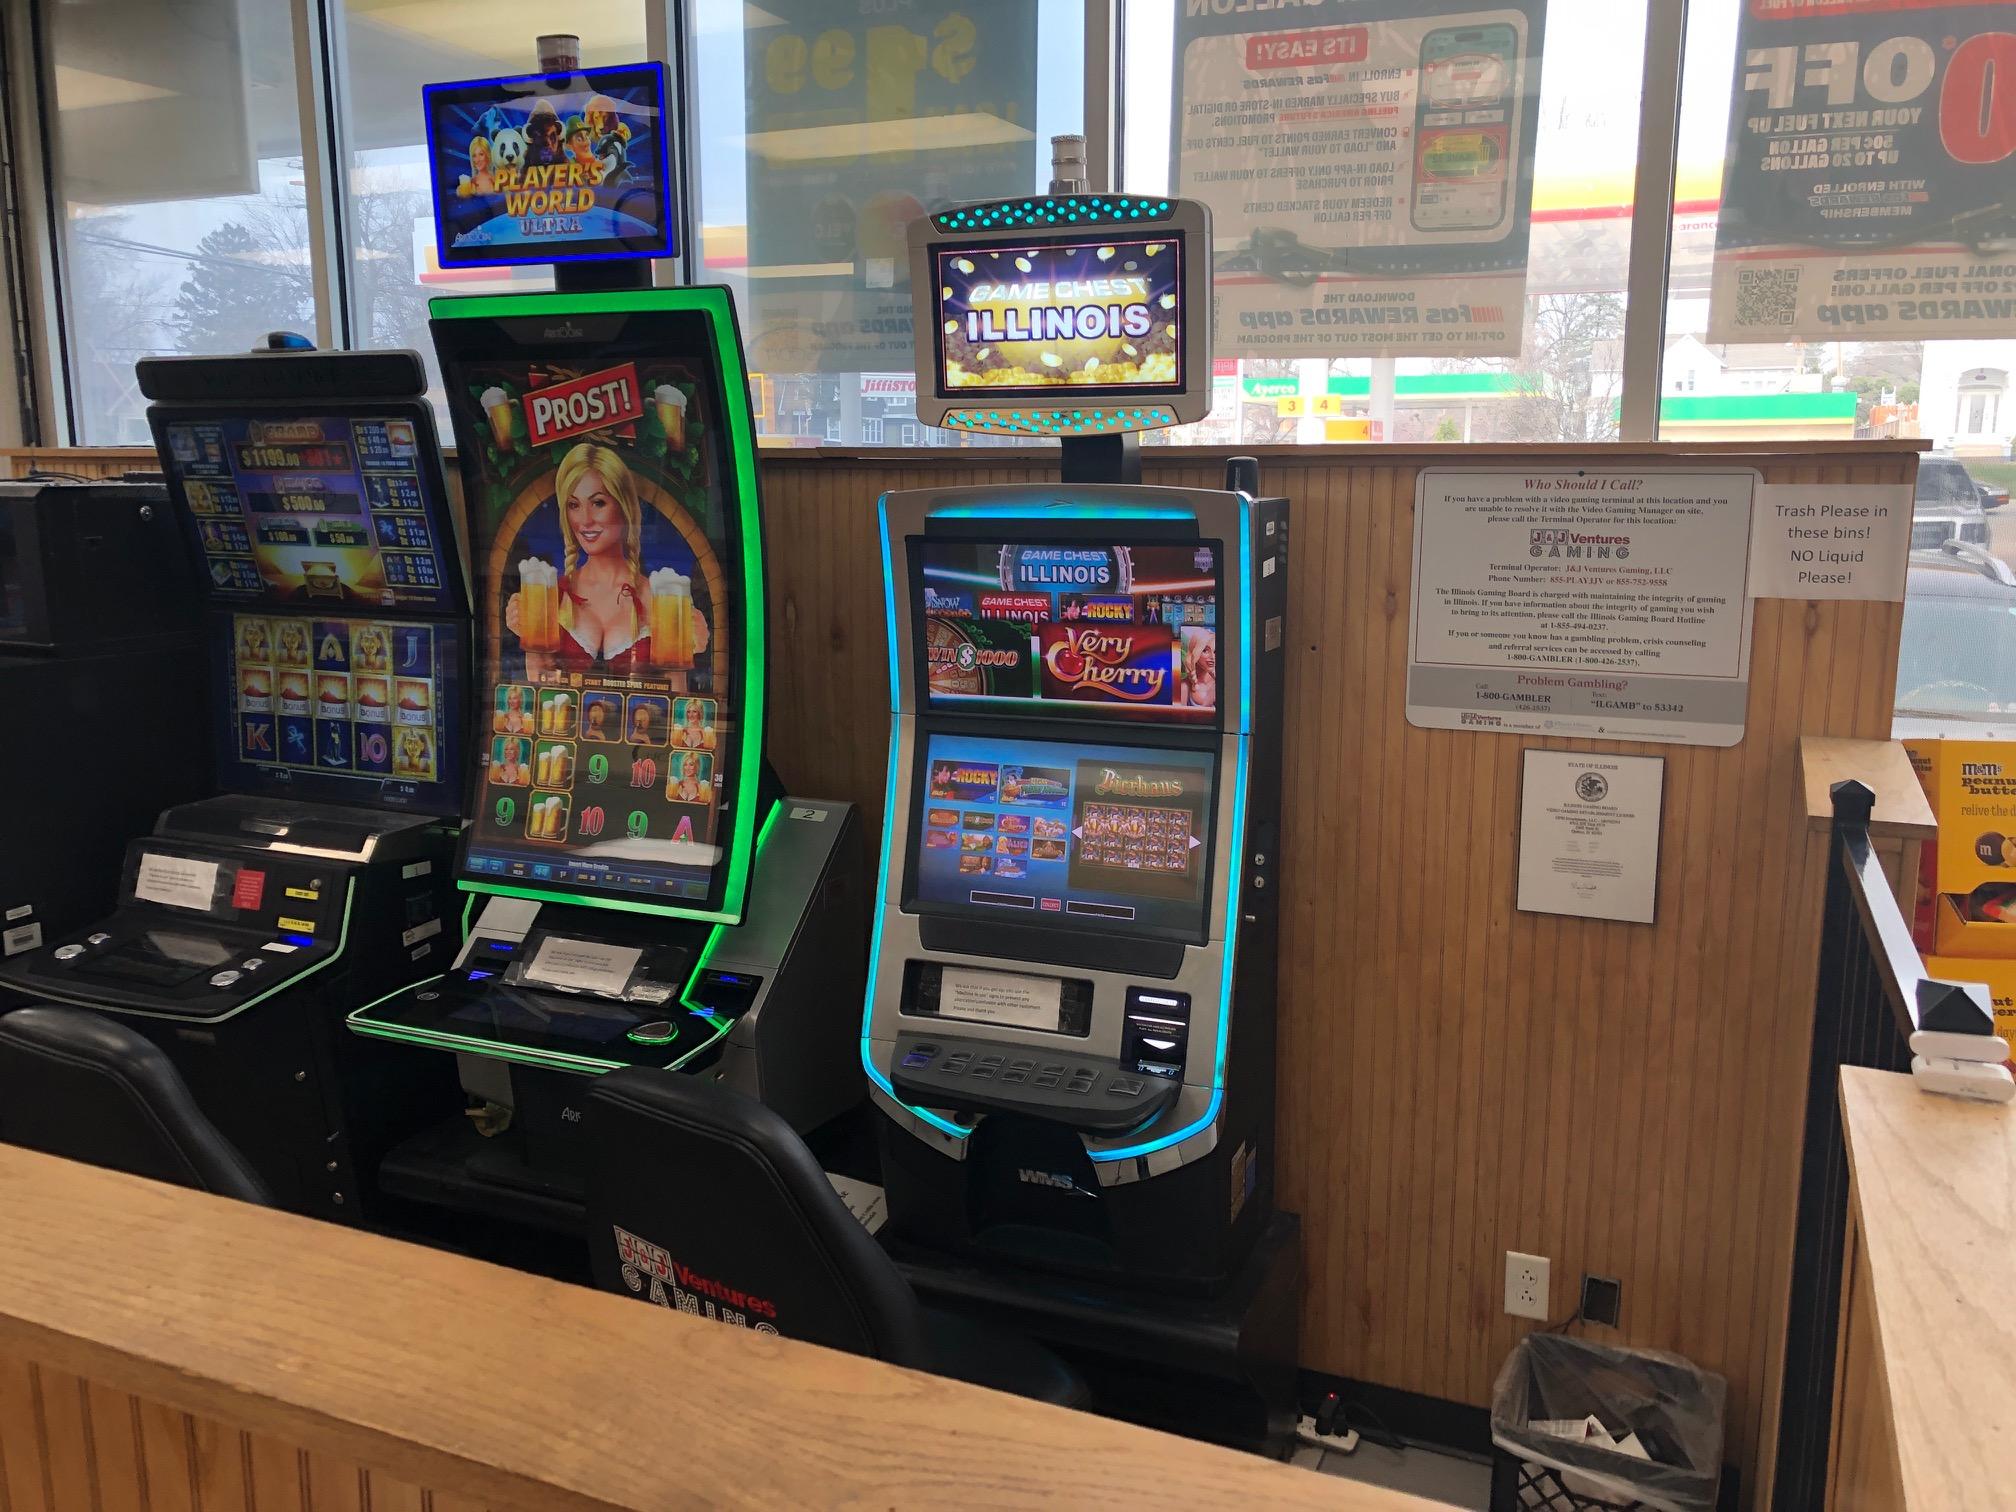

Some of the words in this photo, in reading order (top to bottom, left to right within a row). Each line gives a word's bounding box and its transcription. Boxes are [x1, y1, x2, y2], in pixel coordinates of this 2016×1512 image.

[494, 164, 603, 192] PLAYER'S
[505, 188, 595, 217] WORLD
[520, 216, 583, 236] ULTRA
[969, 281, 1050, 302] GAME
[1054, 278, 1147, 298] CHEST
[966, 303, 1151, 342] ILLINOIS
[1253, 383, 1296, 396] Ayerco
[532, 378, 631, 436] PROST!
[1288, 401, 1296, 412] 3
[1320, 400, 1328, 410] 4
[1524, 479, 1551, 489] Who
[1555, 479, 1597, 490] Should
[1601, 480, 1607, 490] I
[1611, 480, 1643, 490] Call?
[1606, 507, 1636, 515] Gaming
[1775, 504, 1818, 518] Trash
[1822, 504, 1867, 519] Please
[1872, 504, 1888, 518] in
[1576, 516, 1610, 524] Operator
[1571, 533, 1630, 545] Ventures
[1788, 525, 1828, 540] these
[1832, 525, 1872, 540] bins!
[1021, 550, 1061, 561] GAME
[1064, 551, 1108, 561] CHEST
[1790, 549, 1814, 563] NO
[1818, 549, 1865, 566] Liquid
[1021, 565, 1110, 584] ILLINOIS
[1524, 564, 1561, 573] Operator:
[1584, 565, 1616, 573] Ventures
[1619, 567, 1652, 576] Gaming,
[1488, 575, 1512, 583] Phone
[1798, 571, 1853, 585] Please!
[982, 597, 1012, 606] GAME
[1014, 598, 1048, 607] CHEST
[1087, 602, 1134, 620] ROCKY
[1065, 628, 1132, 665] Very
[1507, 654, 1573, 663] 1-800-GAMBLER
[1047, 640, 1167, 700] Cherry
[1518, 675, 1564, 686] Problem
[1567, 678, 1628, 691] Gambling?
[1476, 692, 1551, 703] 1-800-GAMBLER
[1654, 704, 1683, 712] 53342
[245, 722, 272, 752] K
[360, 732, 388, 763] 10
[588, 754, 608, 784] 9
[630, 758, 656, 788] 10
[957, 769, 998, 785] ROCKY
[1961, 804, 1989, 817] relive
[1991, 805, 2008, 817] the
[496, 797, 515, 826] 9
[578, 806, 604, 836] 10
[627, 810, 648, 840] 9
[672, 815, 694, 846] A
[674, 1261, 777, 1319] Ventures
